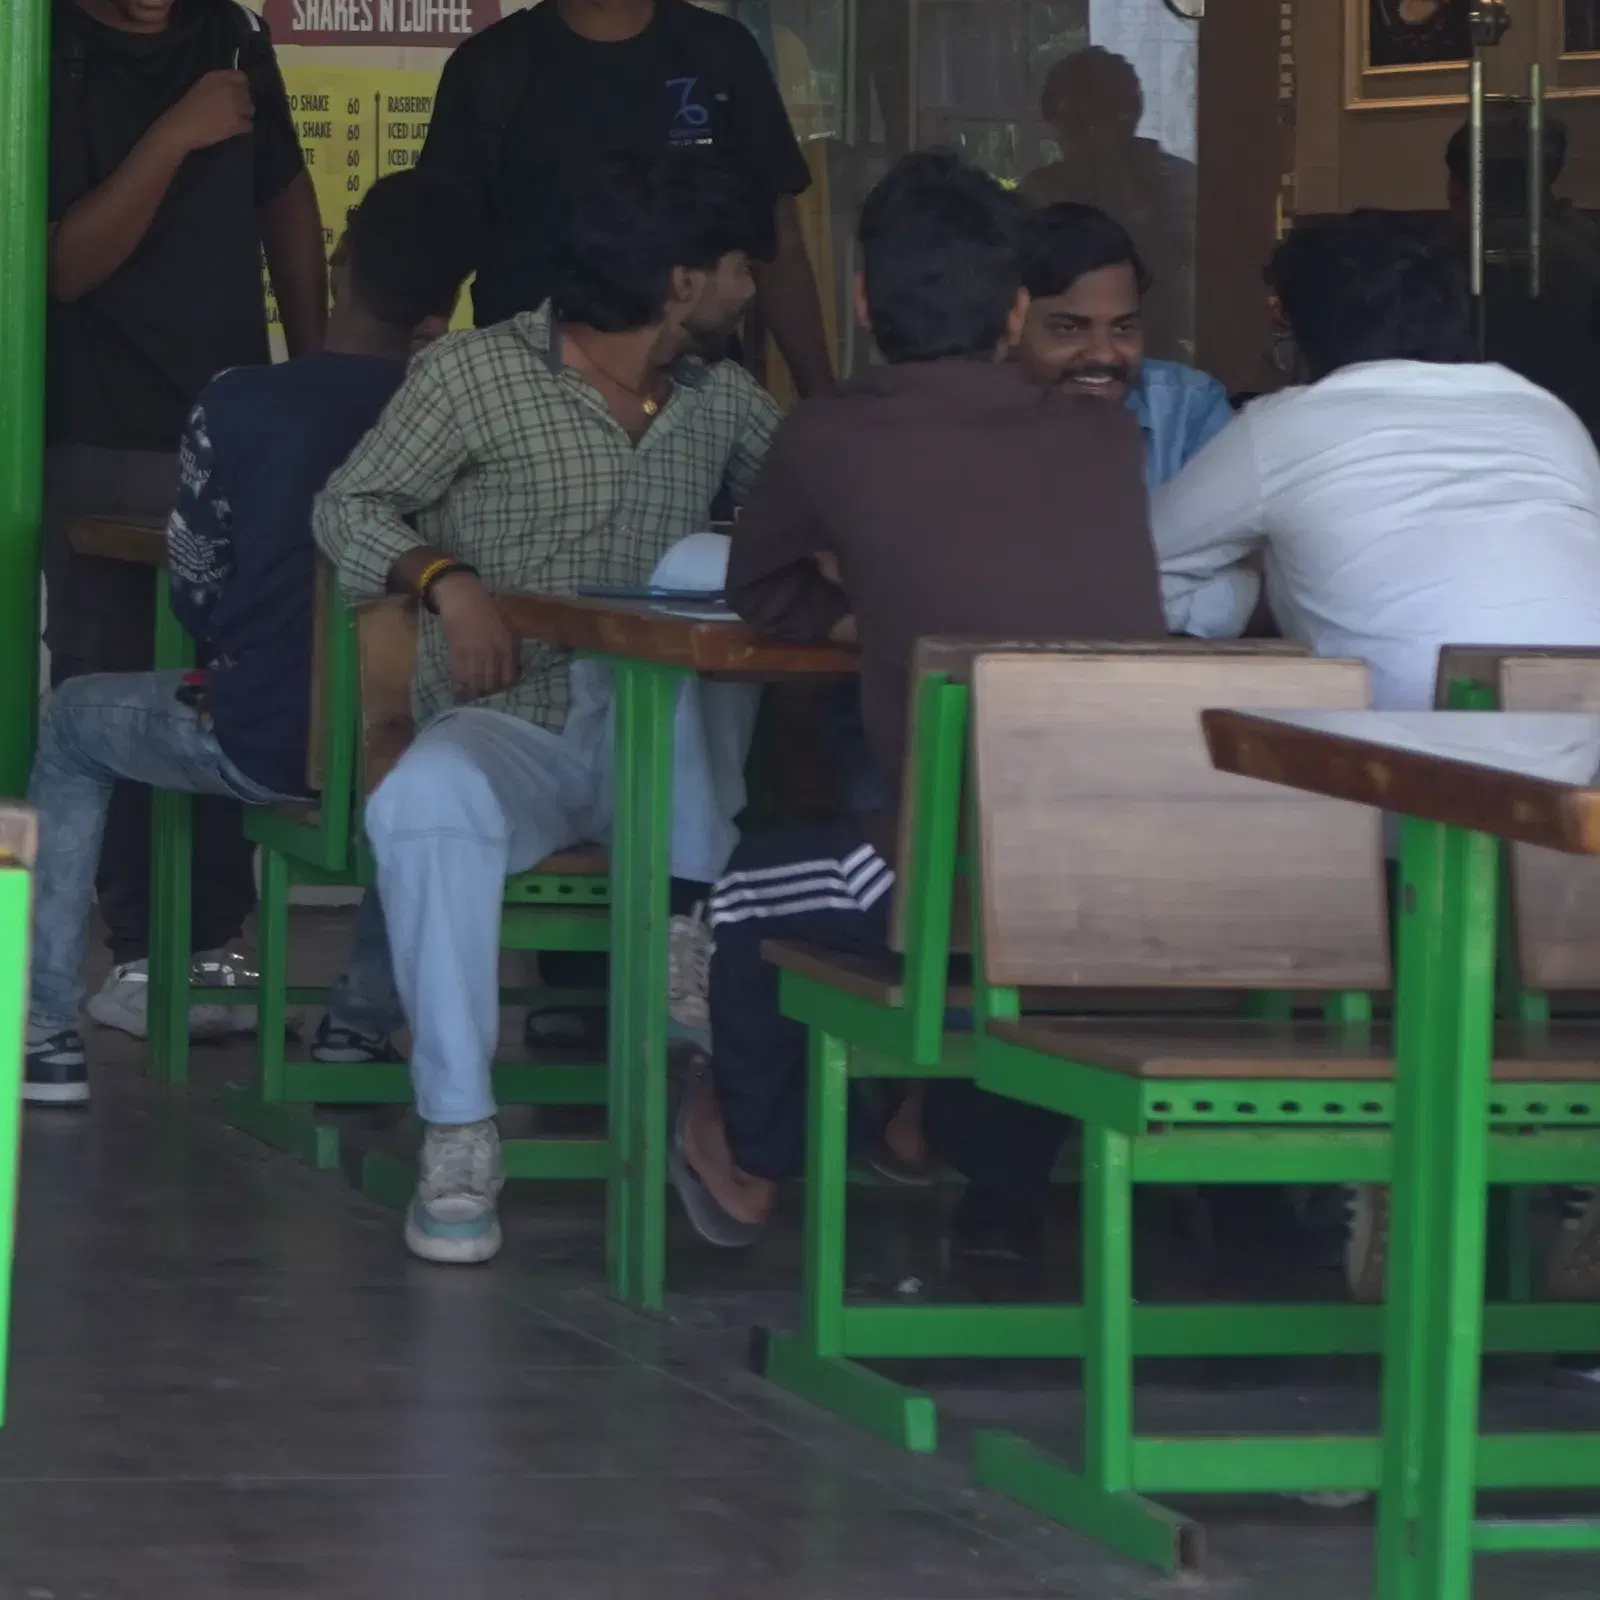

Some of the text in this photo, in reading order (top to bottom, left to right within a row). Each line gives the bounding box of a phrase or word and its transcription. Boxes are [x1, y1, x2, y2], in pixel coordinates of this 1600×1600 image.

[300, 94, 330, 112] SHAKE
[347, 98, 360, 115] 60
[387, 96, 432, 114] RASBERRY
[302, 121, 360, 141] SHAKE 60
[388, 122, 408, 139] ICED
[347, 150, 360, 167] 60
[388, 150, 408, 166] ICED
[346, 175, 360, 192] 60
